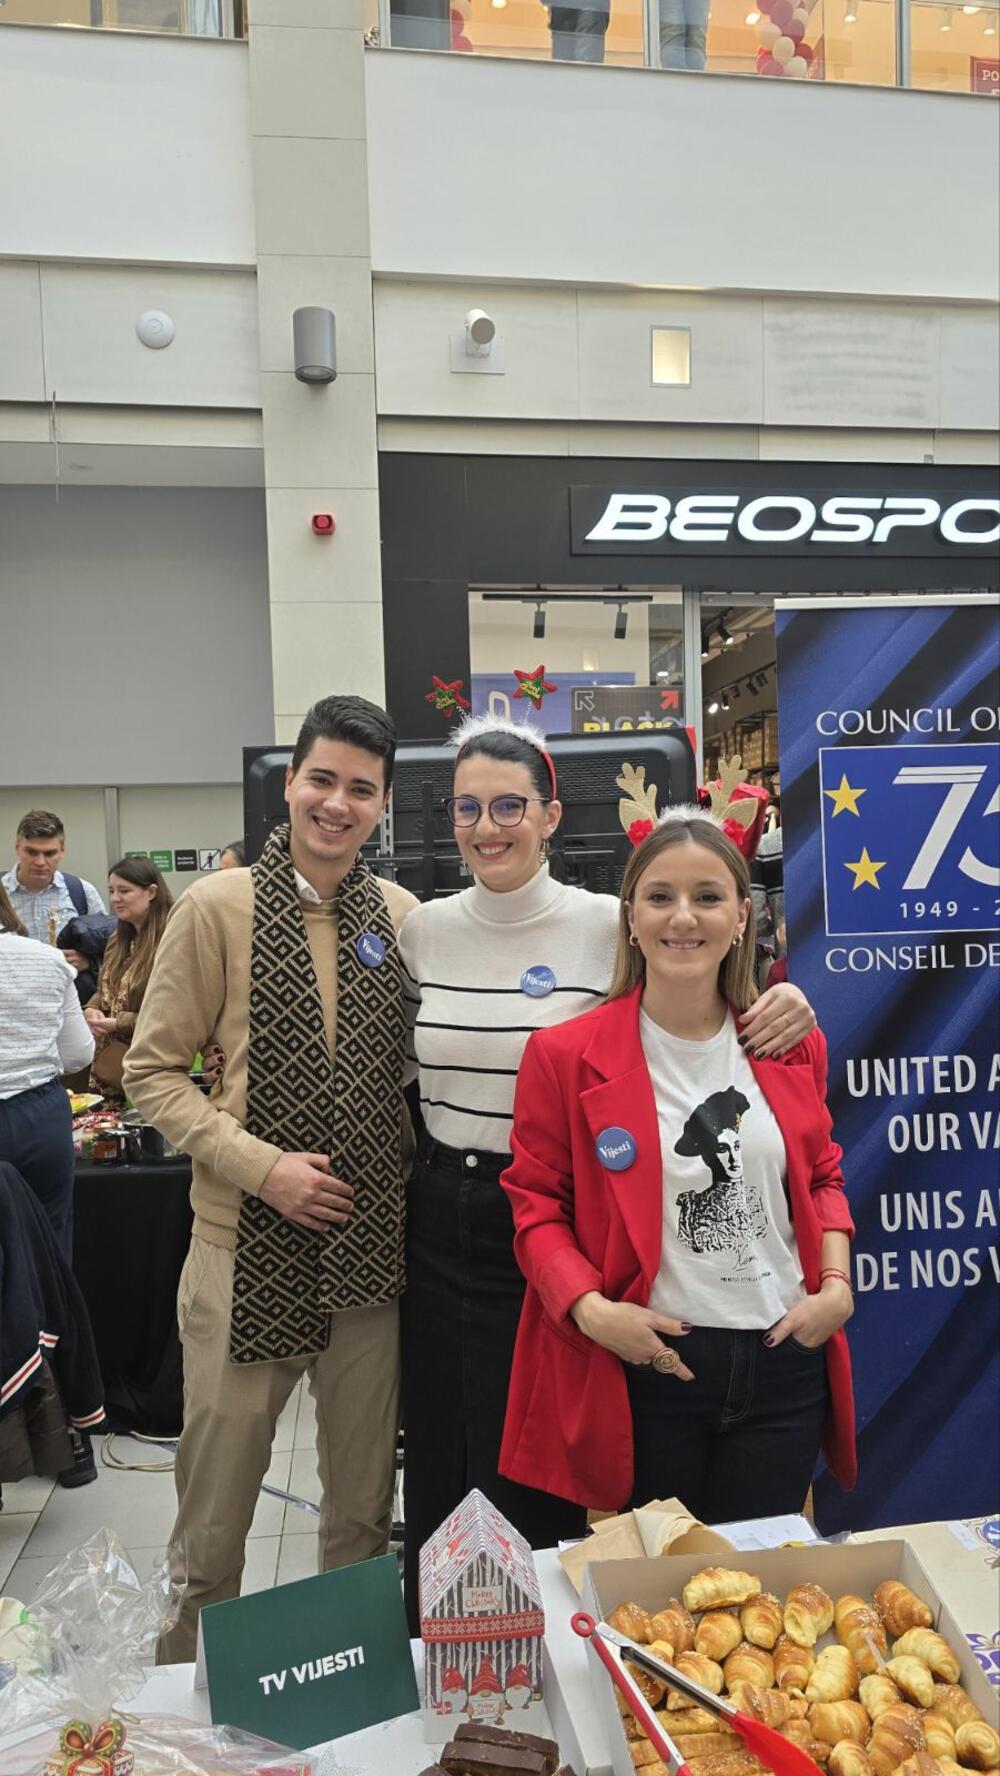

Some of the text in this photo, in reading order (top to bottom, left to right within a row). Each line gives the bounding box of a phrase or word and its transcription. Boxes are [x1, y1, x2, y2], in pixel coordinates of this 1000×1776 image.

[815, 706, 1000, 736] COUNCIL O
[899, 900, 958, 919] 1949
[825, 942, 1000, 972] CONSEIL DE
[847, 1054, 977, 1098] UNITED
[888, 1111, 1000, 1153] OUR V
[880, 1190, 965, 1232] UNIS
[856, 1251, 900, 1292] DE
[910, 1247, 982, 1288] NOS
[258, 1645, 365, 1695] TV VIJESTI
